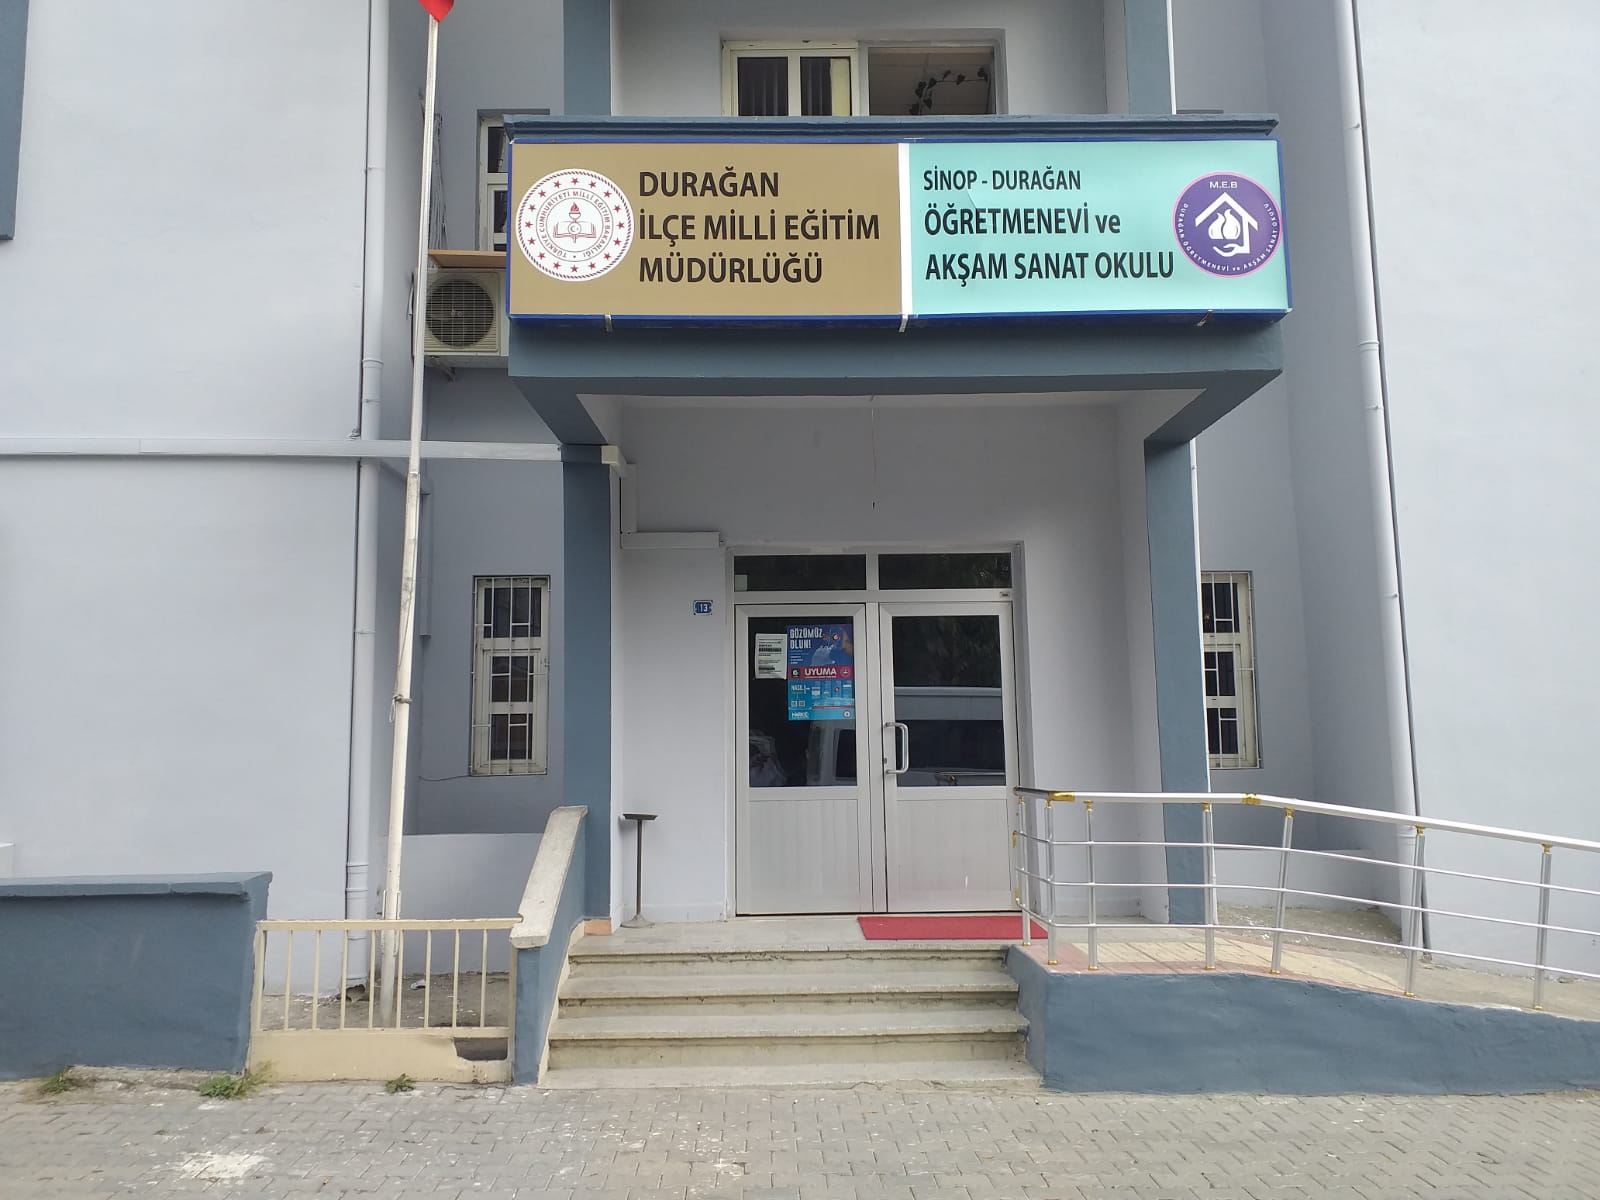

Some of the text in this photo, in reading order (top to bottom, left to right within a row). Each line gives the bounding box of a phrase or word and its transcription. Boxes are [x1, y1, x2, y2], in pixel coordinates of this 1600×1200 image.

[639, 166, 779, 197] DURAĞAN
[923, 165, 977, 191] SİNOP
[992, 165, 1081, 191] DURAĞAN
[539, 191, 570, 233] CUMHURİYETİ
[594, 198, 610, 223] EĞİTİM
[924, 202, 1121, 235] ÖĞRETMENEVİ ve
[583, 224, 611, 258] BAKANLIĞI
[639, 209, 880, 247] İLÇE MİLLİ EĞİTİM
[540, 232, 567, 259] TÜRKİYE
[639, 252, 822, 283] MÜDÜRLÜĞÜ
[925, 251, 1174, 286] AKŞAM SANAT OKULU
[700, 603, 708, 613] 13
[790, 627, 823, 639] GÖZÜMÜZ
[804, 668, 837, 676] UYUMA
